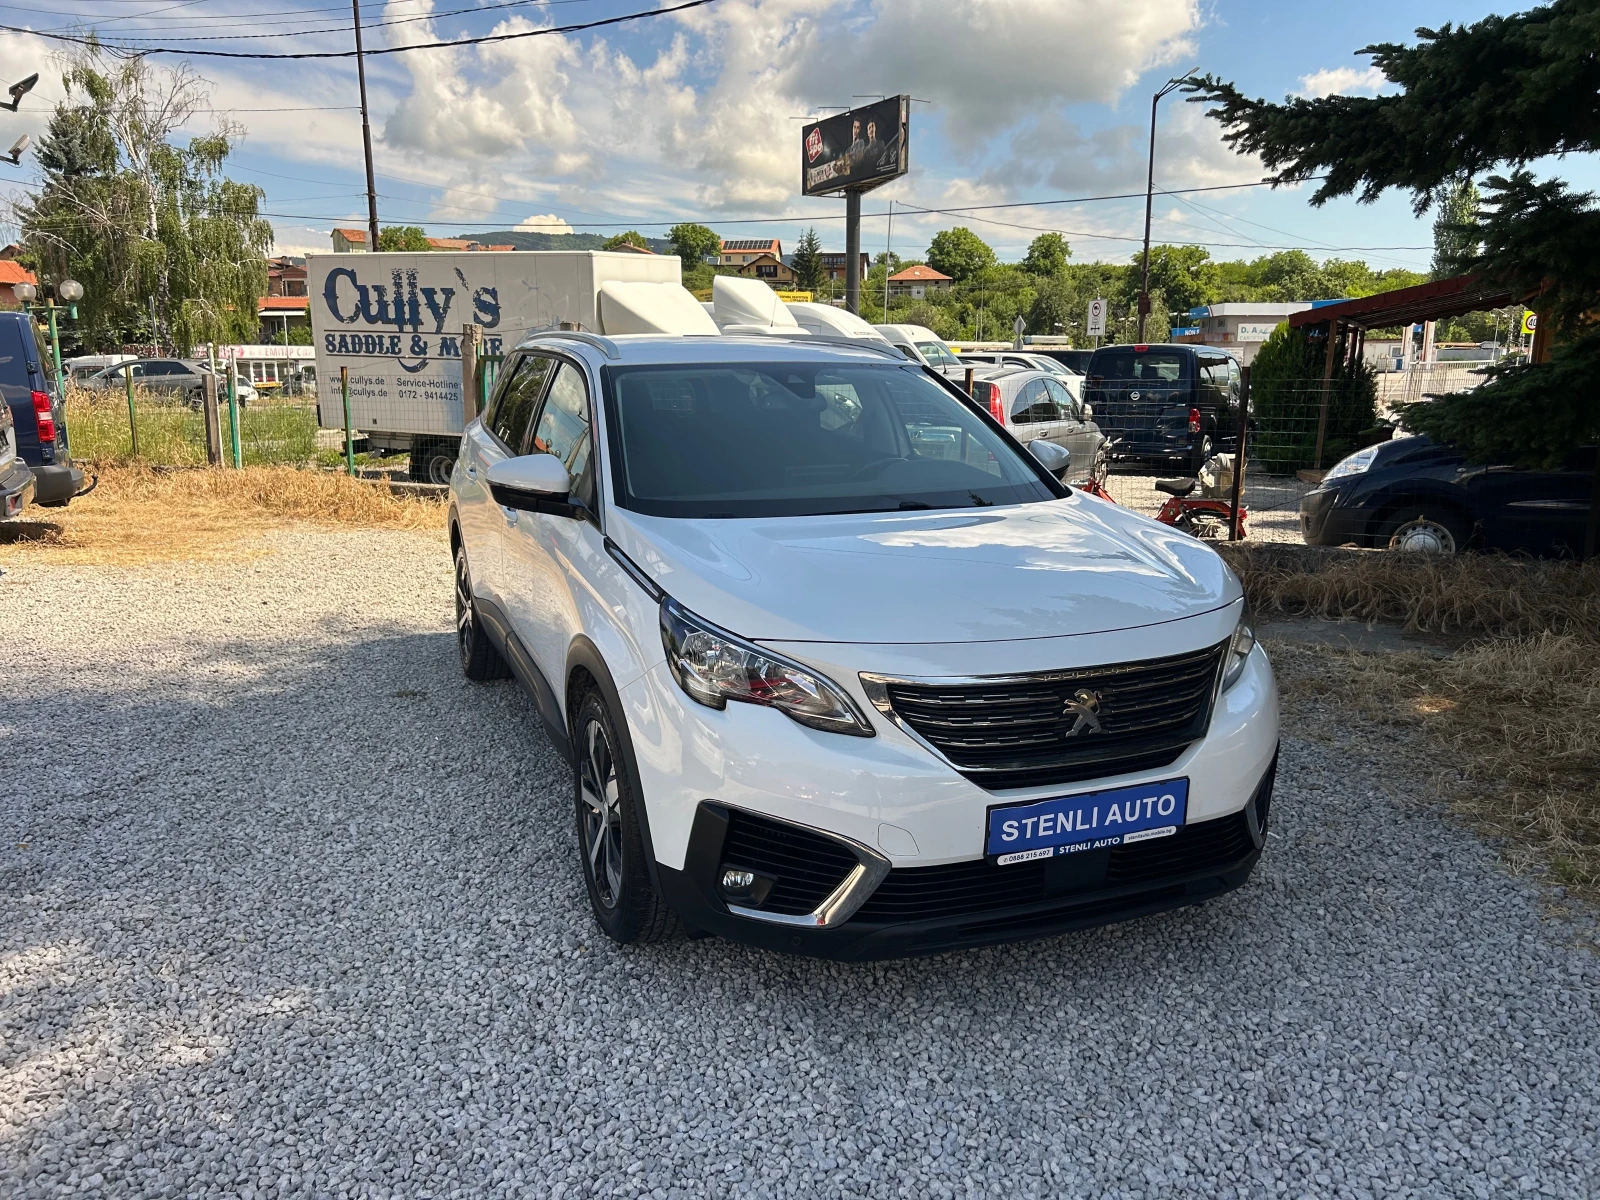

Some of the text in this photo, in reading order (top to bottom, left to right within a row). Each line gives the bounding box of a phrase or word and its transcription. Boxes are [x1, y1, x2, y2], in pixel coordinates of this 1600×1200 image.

[325, 333, 504, 357] SADDLE & ME
[329, 376, 385, 387] ww.cullys.de
[397, 377, 459, 389] Service-Hotline
[398, 390, 417, 399] 0172
[424, 391, 459, 401] 9414425
[1001, 794, 1176, 842] STENLI AUTO
[1059, 837, 1120, 854] STENLI AUTO
[1008, 850, 1051, 862] 0888 215 697
